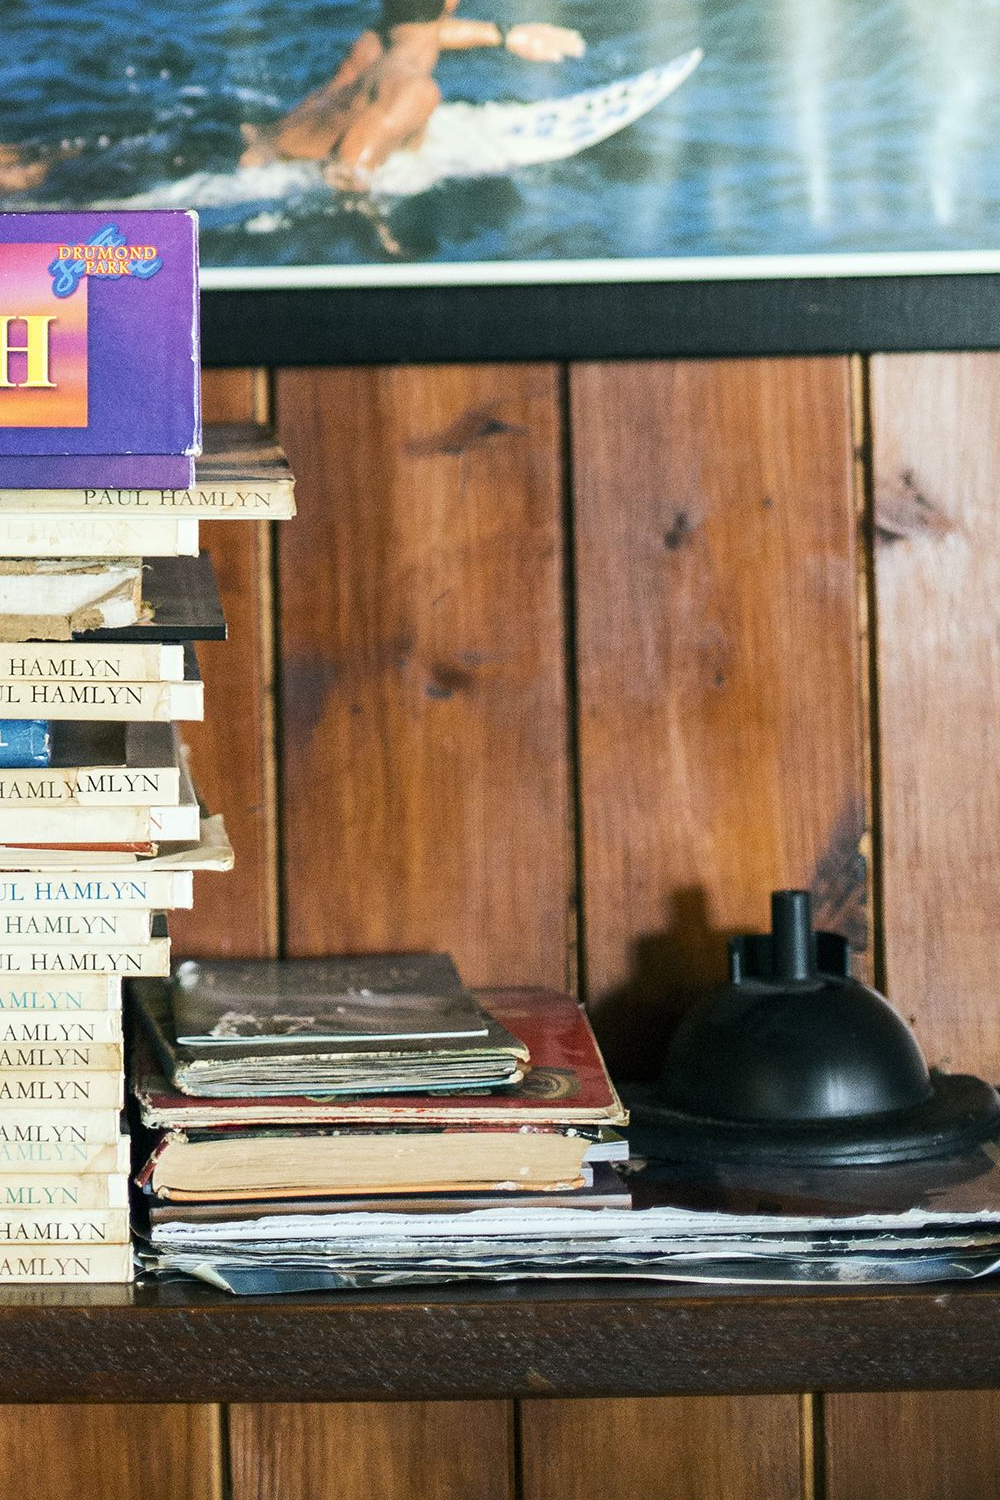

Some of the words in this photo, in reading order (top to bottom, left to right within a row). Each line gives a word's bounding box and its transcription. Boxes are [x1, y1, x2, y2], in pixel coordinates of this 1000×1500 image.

[58, 246, 158, 260] DRUMOND
[85, 260, 131, 275] PARK
[83, 489, 149, 507] PAUL
[159, 490, 273, 508] HAMLYN
[9, 659, 121, 677] HAMLYN
[32, 686, 143, 705] HAMLYN
[36, 881, 148, 900] HAMLYN
[5, 916, 117, 934] HAMLYN
[32, 953, 143, 971] HAMLYN
